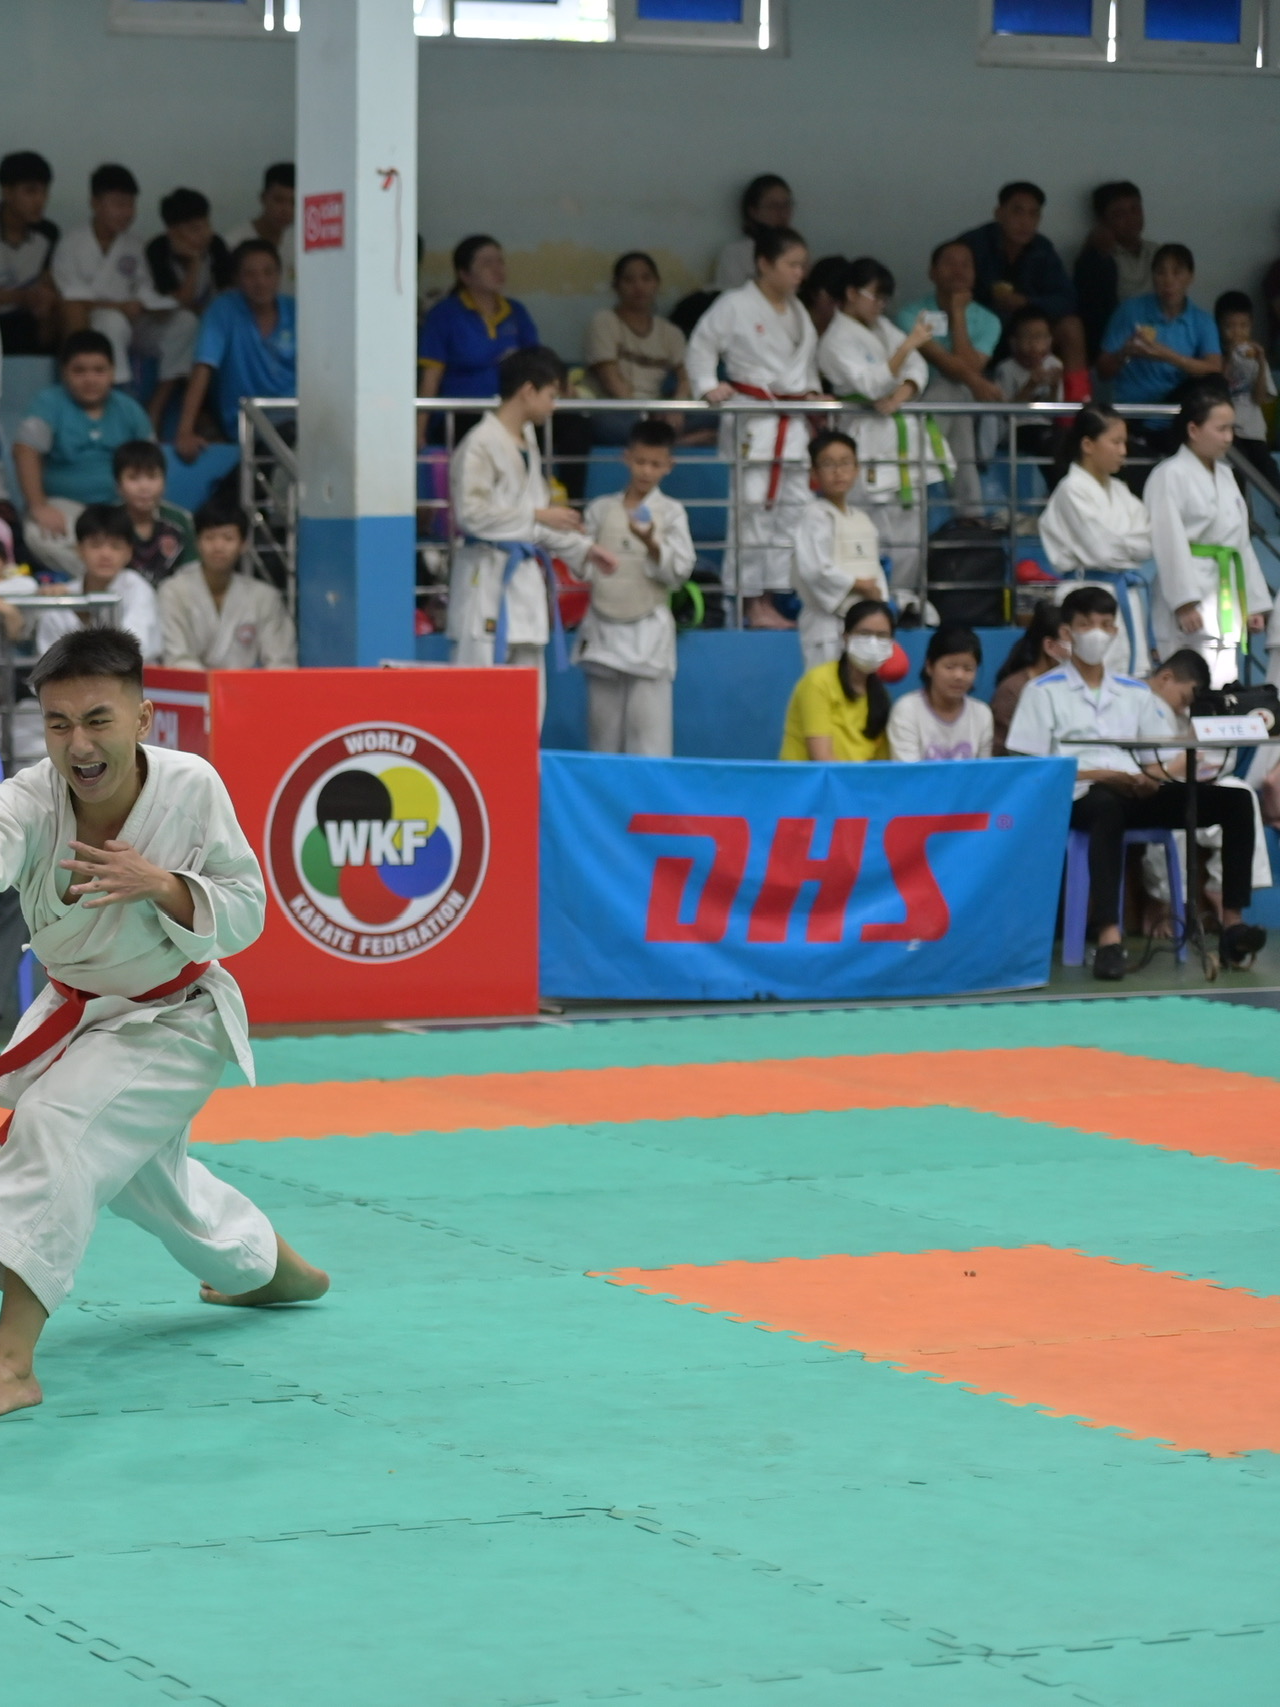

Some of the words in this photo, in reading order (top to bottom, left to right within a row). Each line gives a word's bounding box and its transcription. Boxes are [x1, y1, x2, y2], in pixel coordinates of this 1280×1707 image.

[344, 731, 417, 756] WORLD
[324, 820, 428, 866] WKF
[627, 812, 990, 943] DHS
[289, 893, 356, 951] KARATE
[359, 889, 466, 955] FEDERATION
